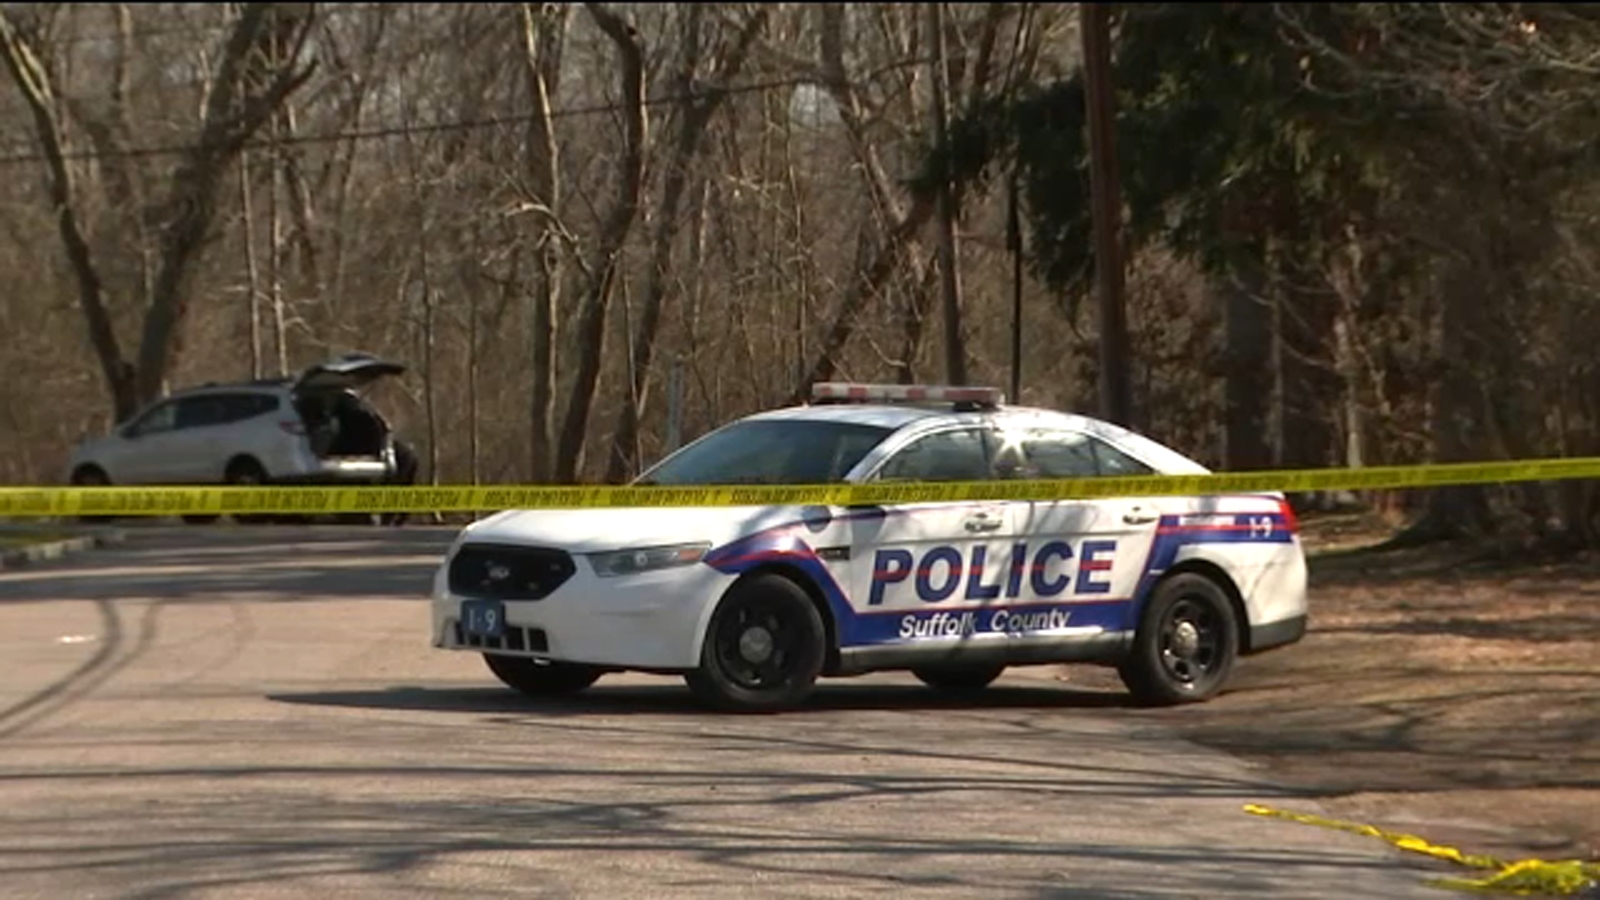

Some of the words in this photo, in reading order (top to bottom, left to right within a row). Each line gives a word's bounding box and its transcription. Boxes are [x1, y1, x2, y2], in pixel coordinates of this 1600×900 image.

[868, 540, 1118, 605] POLICE
[899, 611, 978, 639] Suffolk
[990, 607, 1072, 632] County
